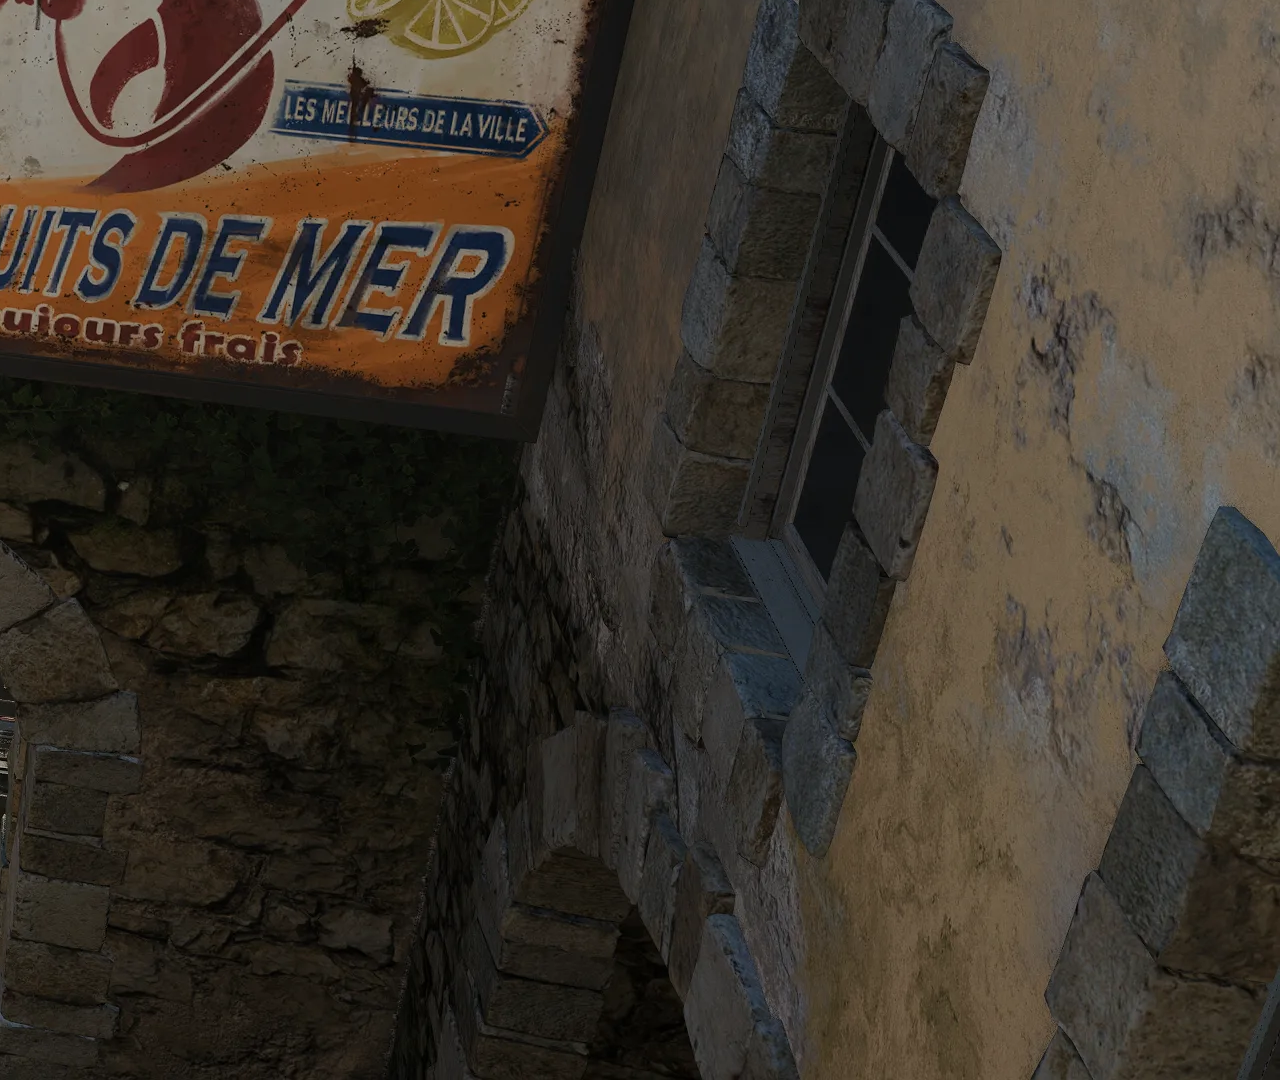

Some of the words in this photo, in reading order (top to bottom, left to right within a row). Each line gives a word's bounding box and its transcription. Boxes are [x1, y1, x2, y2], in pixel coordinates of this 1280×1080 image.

[284, 95, 317, 122] LES
[421, 108, 446, 135] DE
[450, 110, 479, 138] LA
[476, 113, 529, 144] VILLE
[136, 212, 273, 320] DE
[264, 216, 517, 348] MER
[177, 320, 304, 367] frais
